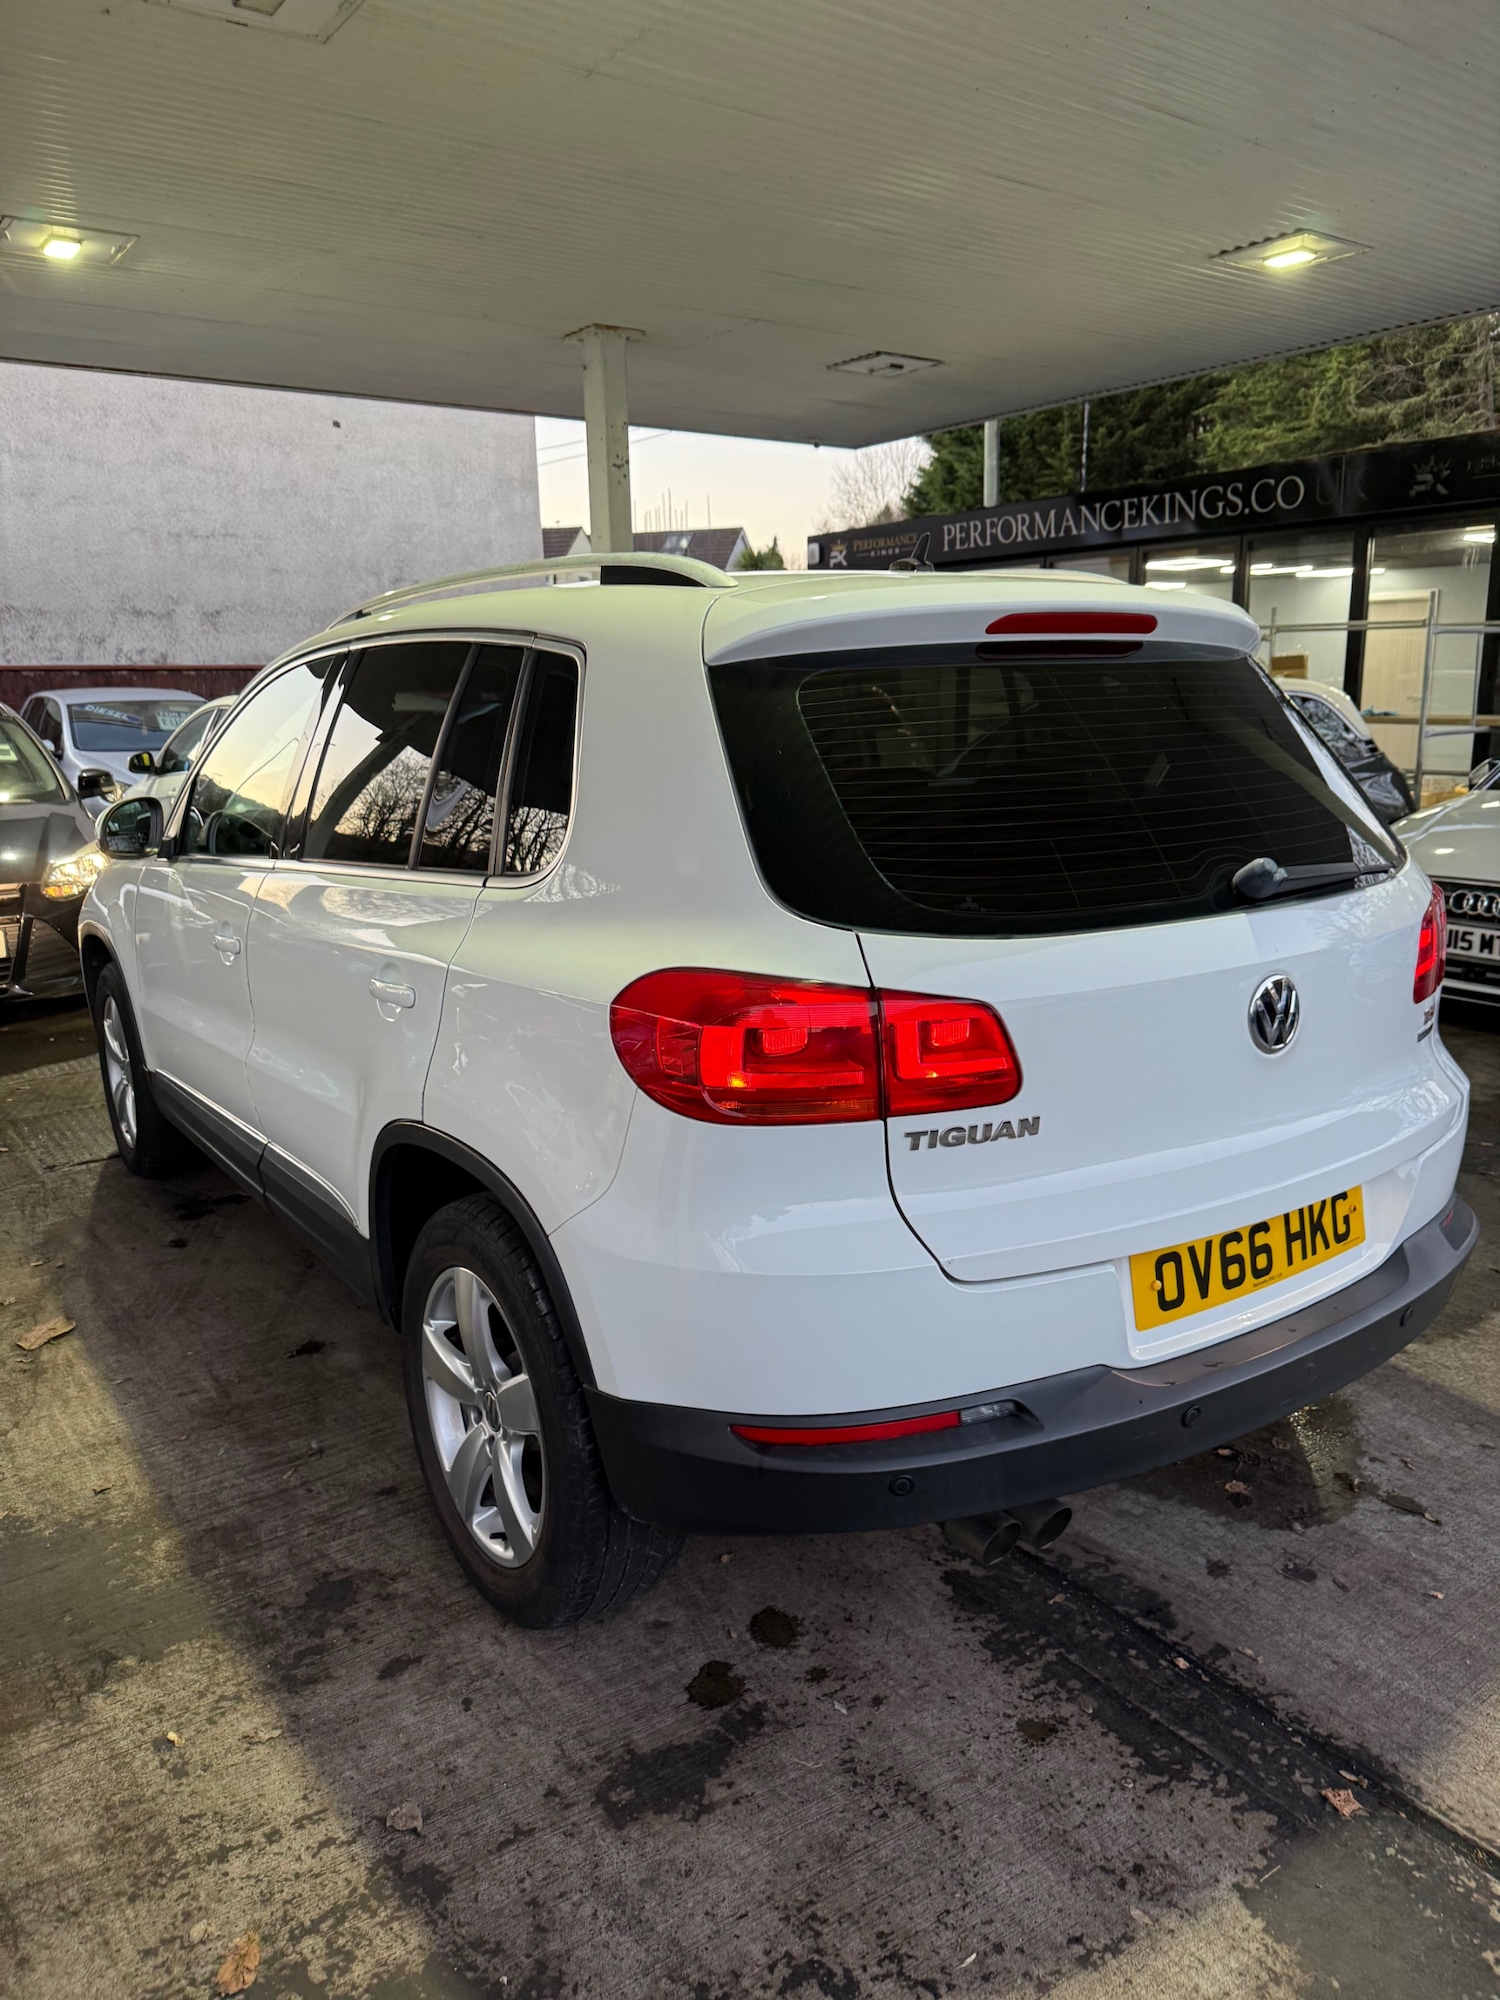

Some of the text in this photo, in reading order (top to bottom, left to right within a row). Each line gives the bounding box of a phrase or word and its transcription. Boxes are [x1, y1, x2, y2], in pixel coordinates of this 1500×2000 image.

[853, 532, 918, 552] PERFORMANCE
[870, 546, 900, 558] KINGS
[84, 703, 129, 721] DIESEL
[904, 1116, 1041, 1151] TIGUAN
[1154, 1190, 1351, 1312] OV66 HKG
